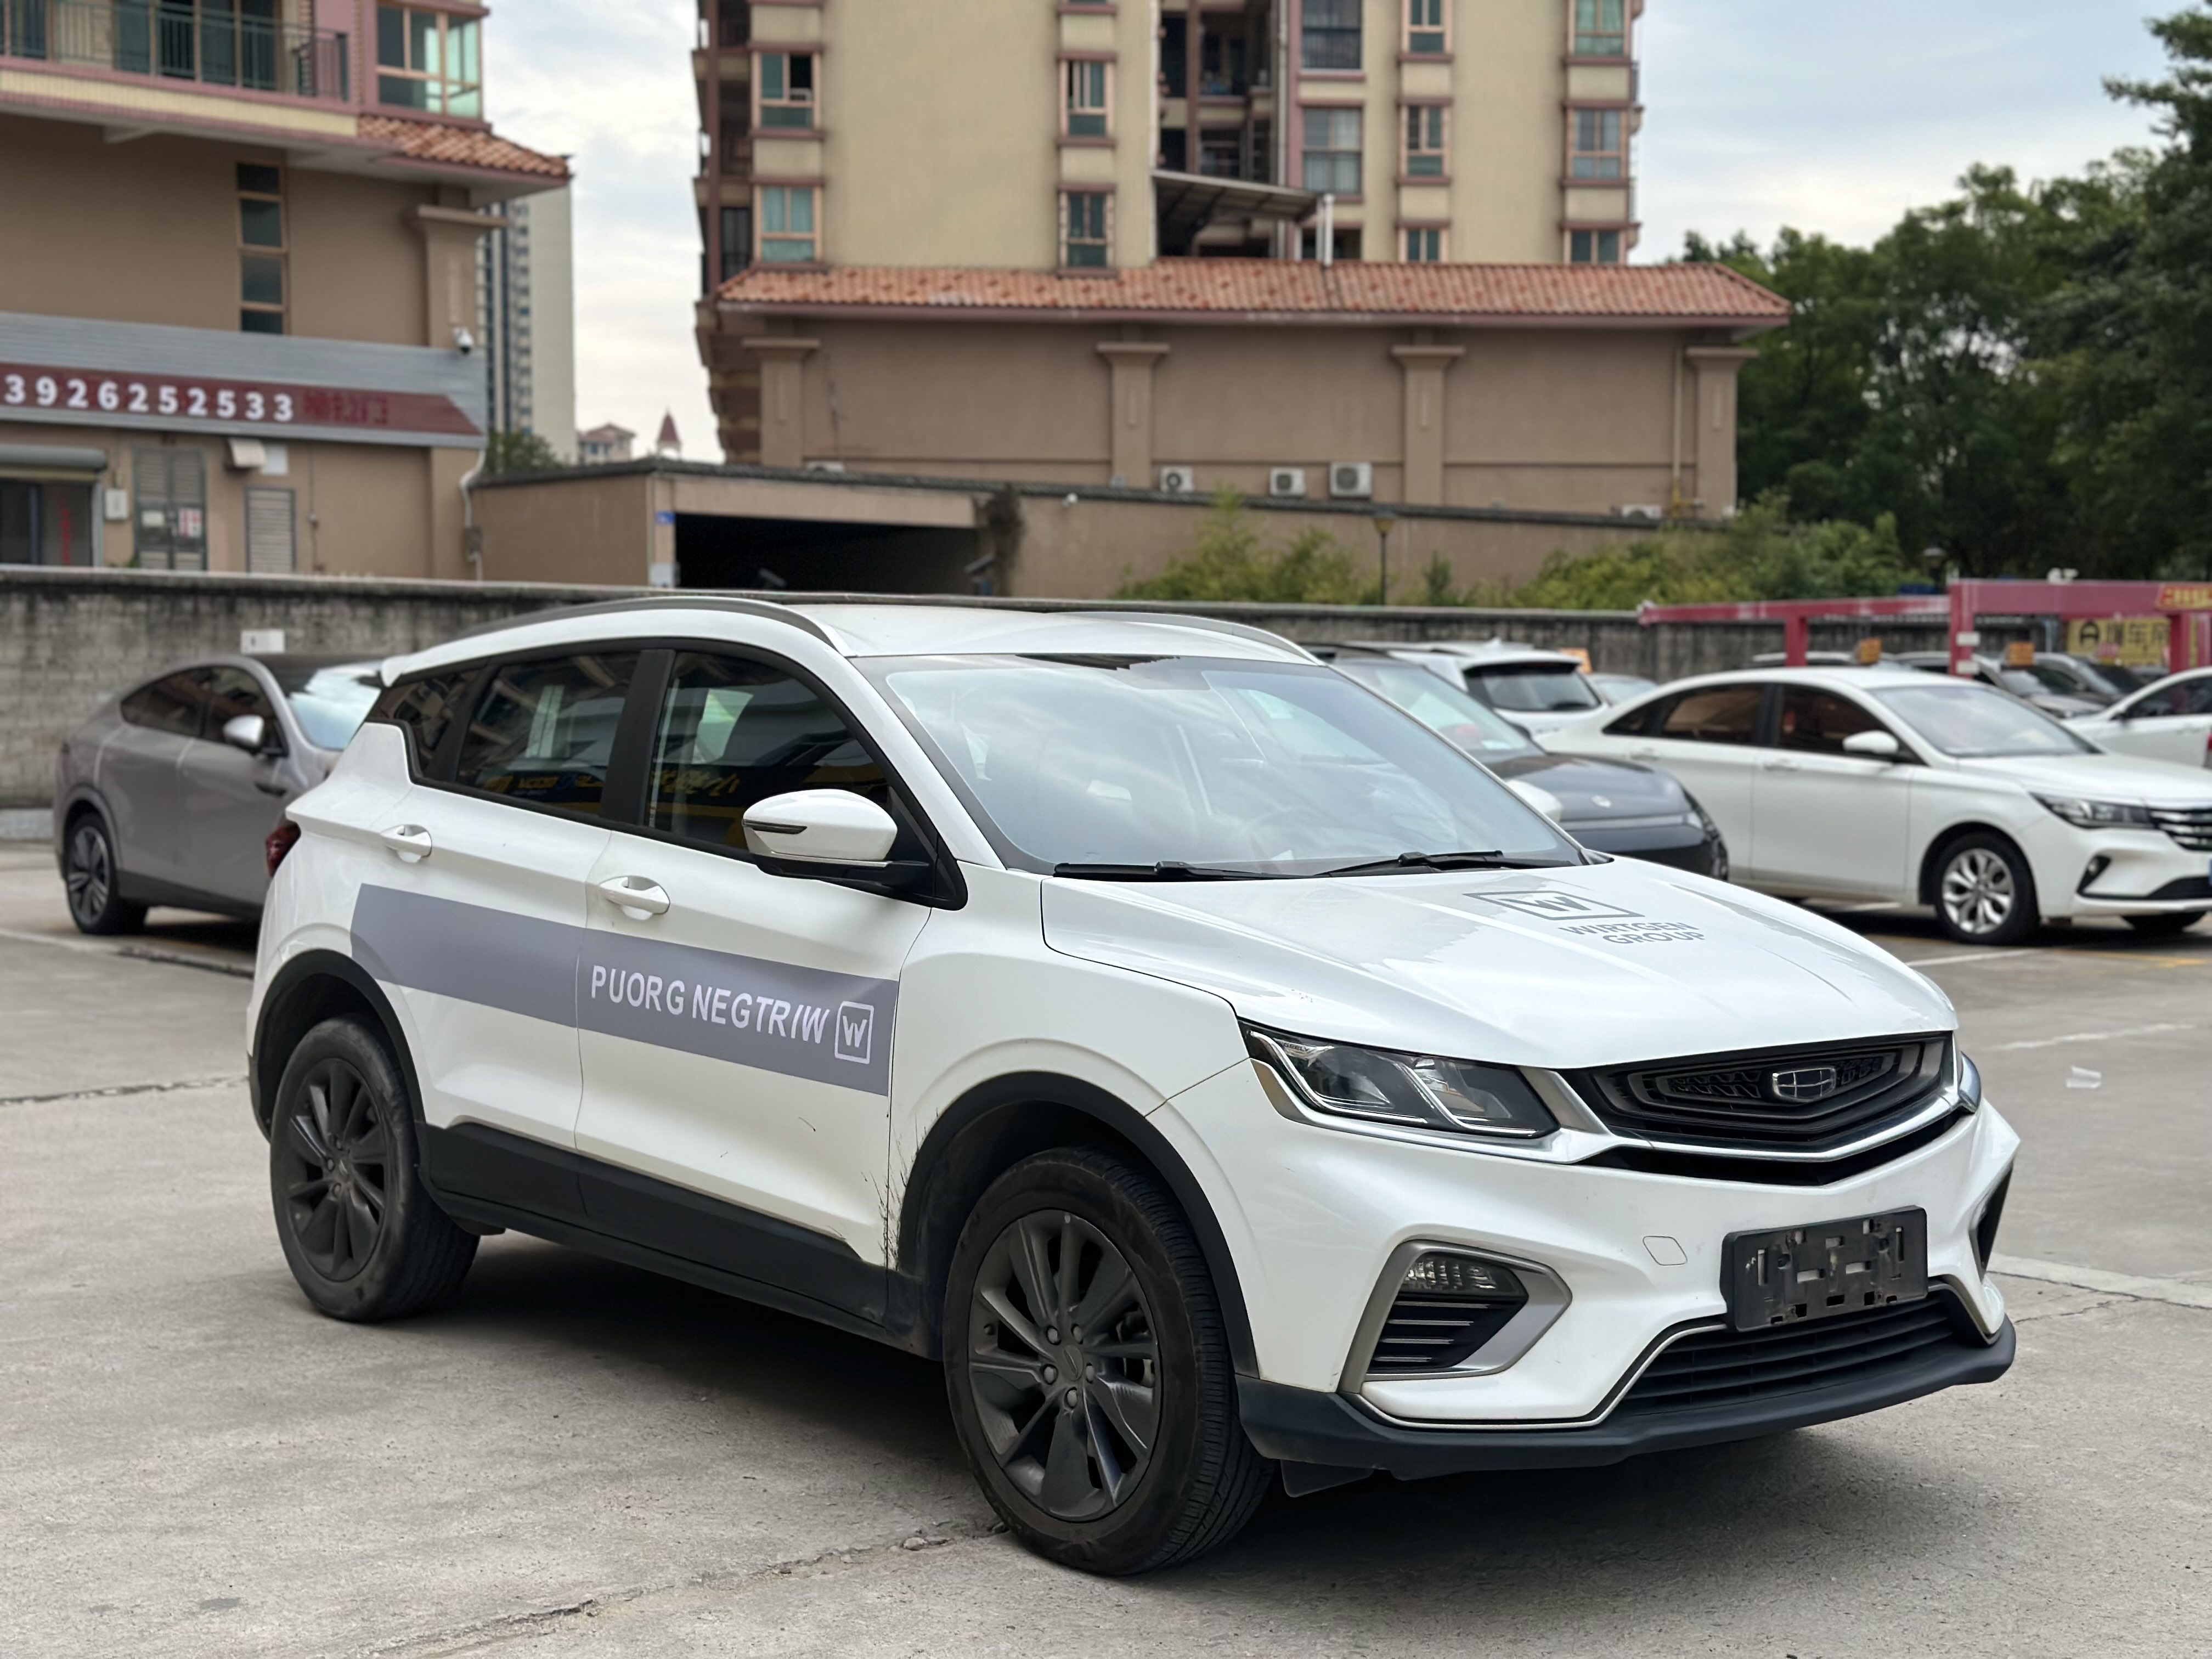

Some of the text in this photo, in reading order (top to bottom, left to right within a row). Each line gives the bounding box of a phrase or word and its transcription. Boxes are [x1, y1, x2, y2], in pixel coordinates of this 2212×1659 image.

[4, 374, 294, 422] 3926252533
[1558, 922, 1700, 935] WIRTGEN
[1602, 932, 1705, 944] GROUP
[591, 965, 831, 1044] PUORG NEGTRIW
[1283, 1042, 1310, 1052] GEELY
